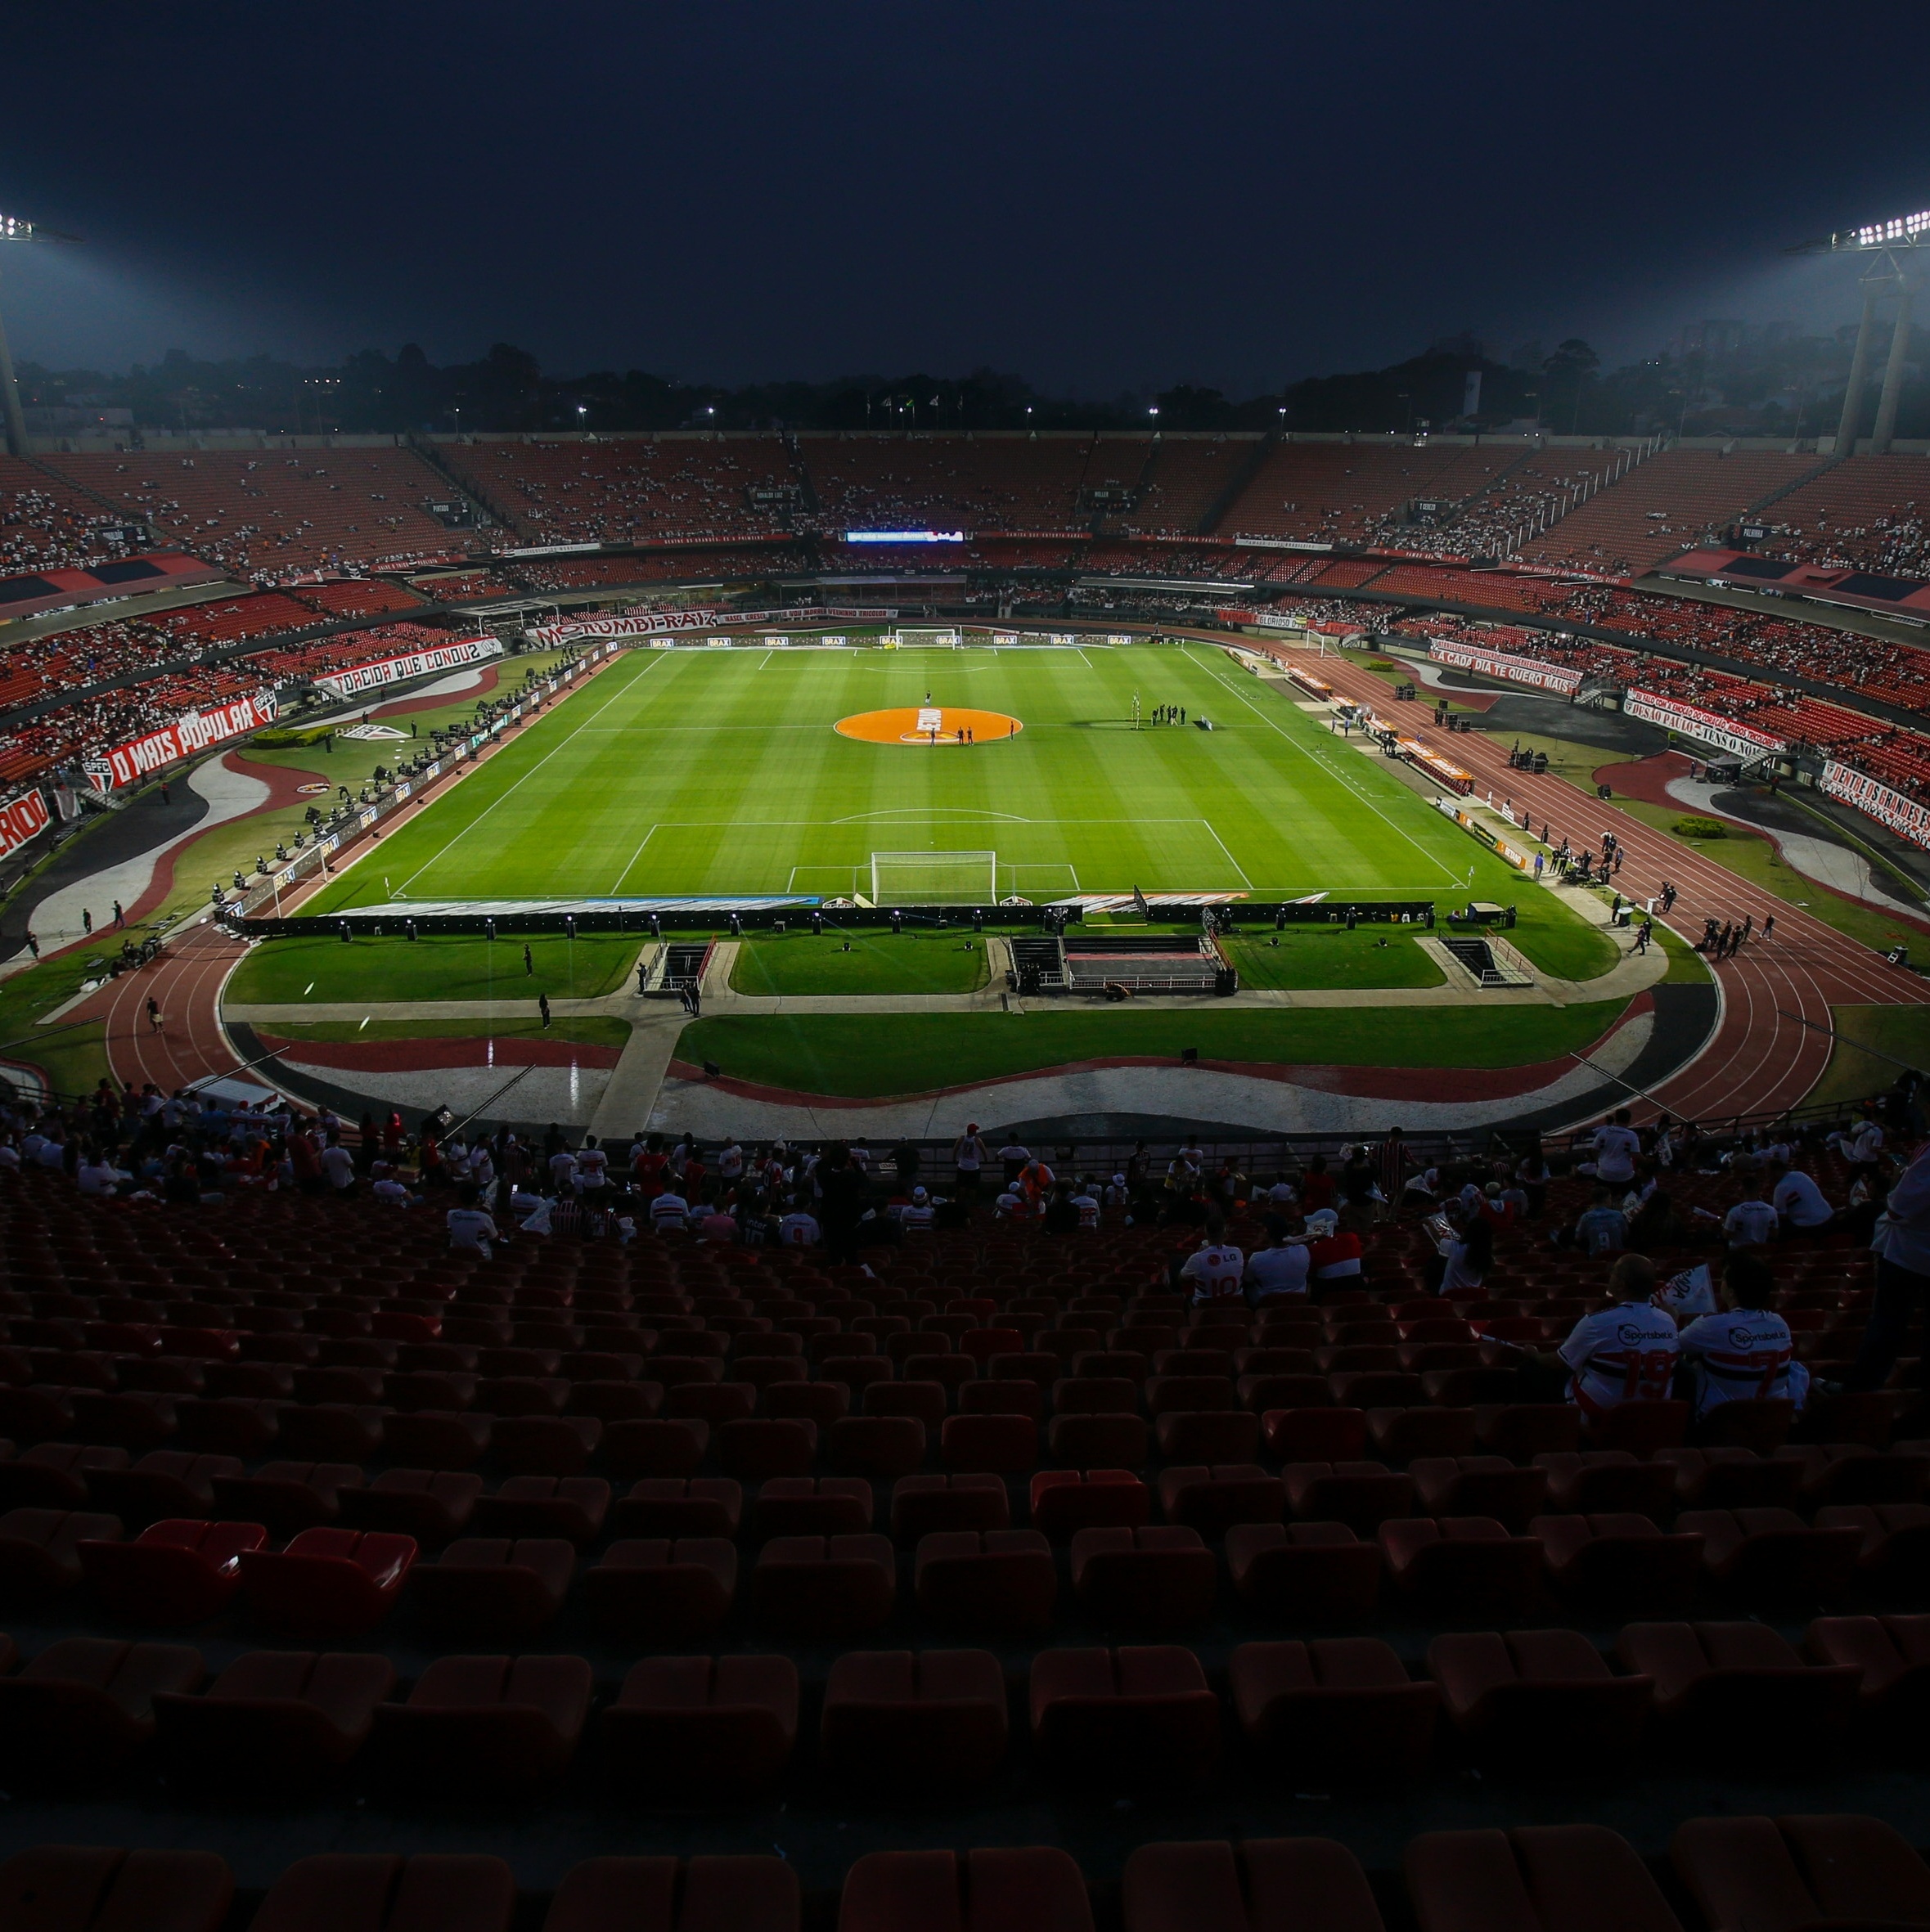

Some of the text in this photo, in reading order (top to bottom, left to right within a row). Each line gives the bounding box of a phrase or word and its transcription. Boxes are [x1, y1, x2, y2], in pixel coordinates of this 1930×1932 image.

[1259, 616, 1289, 627] GLORIOSO
[652, 639, 673, 647] BRAX
[709, 639, 730, 647] BRAX
[767, 638, 788, 646] BRAX
[335, 664, 392, 693] TORCIDA
[396, 657, 421, 679] QUE
[1447, 654, 1473, 667] CADA
[1474, 661, 1491, 673] DIA
[1494, 665, 1507, 677] TE
[1509, 668, 1542, 685] QUERO
[1544, 676, 1568, 692] MAIS
[1643, 694, 1655, 704] FALO
[1663, 714, 1693, 733] PAULO
[1703, 727, 1727, 747] TENS
[1730, 738, 1737, 749] O
[111, 704, 255, 784] O MAIS POPULAR
[85, 761, 110, 773] SPFC
[1833, 766, 1866, 795] DENTRE
[1866, 783, 1880, 801] OS
[1879, 789, 1920, 824] GRANDES
[320, 835, 339, 857] BRAX
[1504, 846, 1522, 865] BETANO
[747, 1218, 767, 1229] inter
[1223, 1253, 1237, 1262] LG
[1211, 1276, 1237, 1297] 10
[1624, 1329, 1673, 1341] Sportsbet.io
[1735, 1330, 1786, 1343] Sportsbet.io
[1623, 1350, 1672, 1399] 19
[1748, 1350, 1779, 1401] 7
